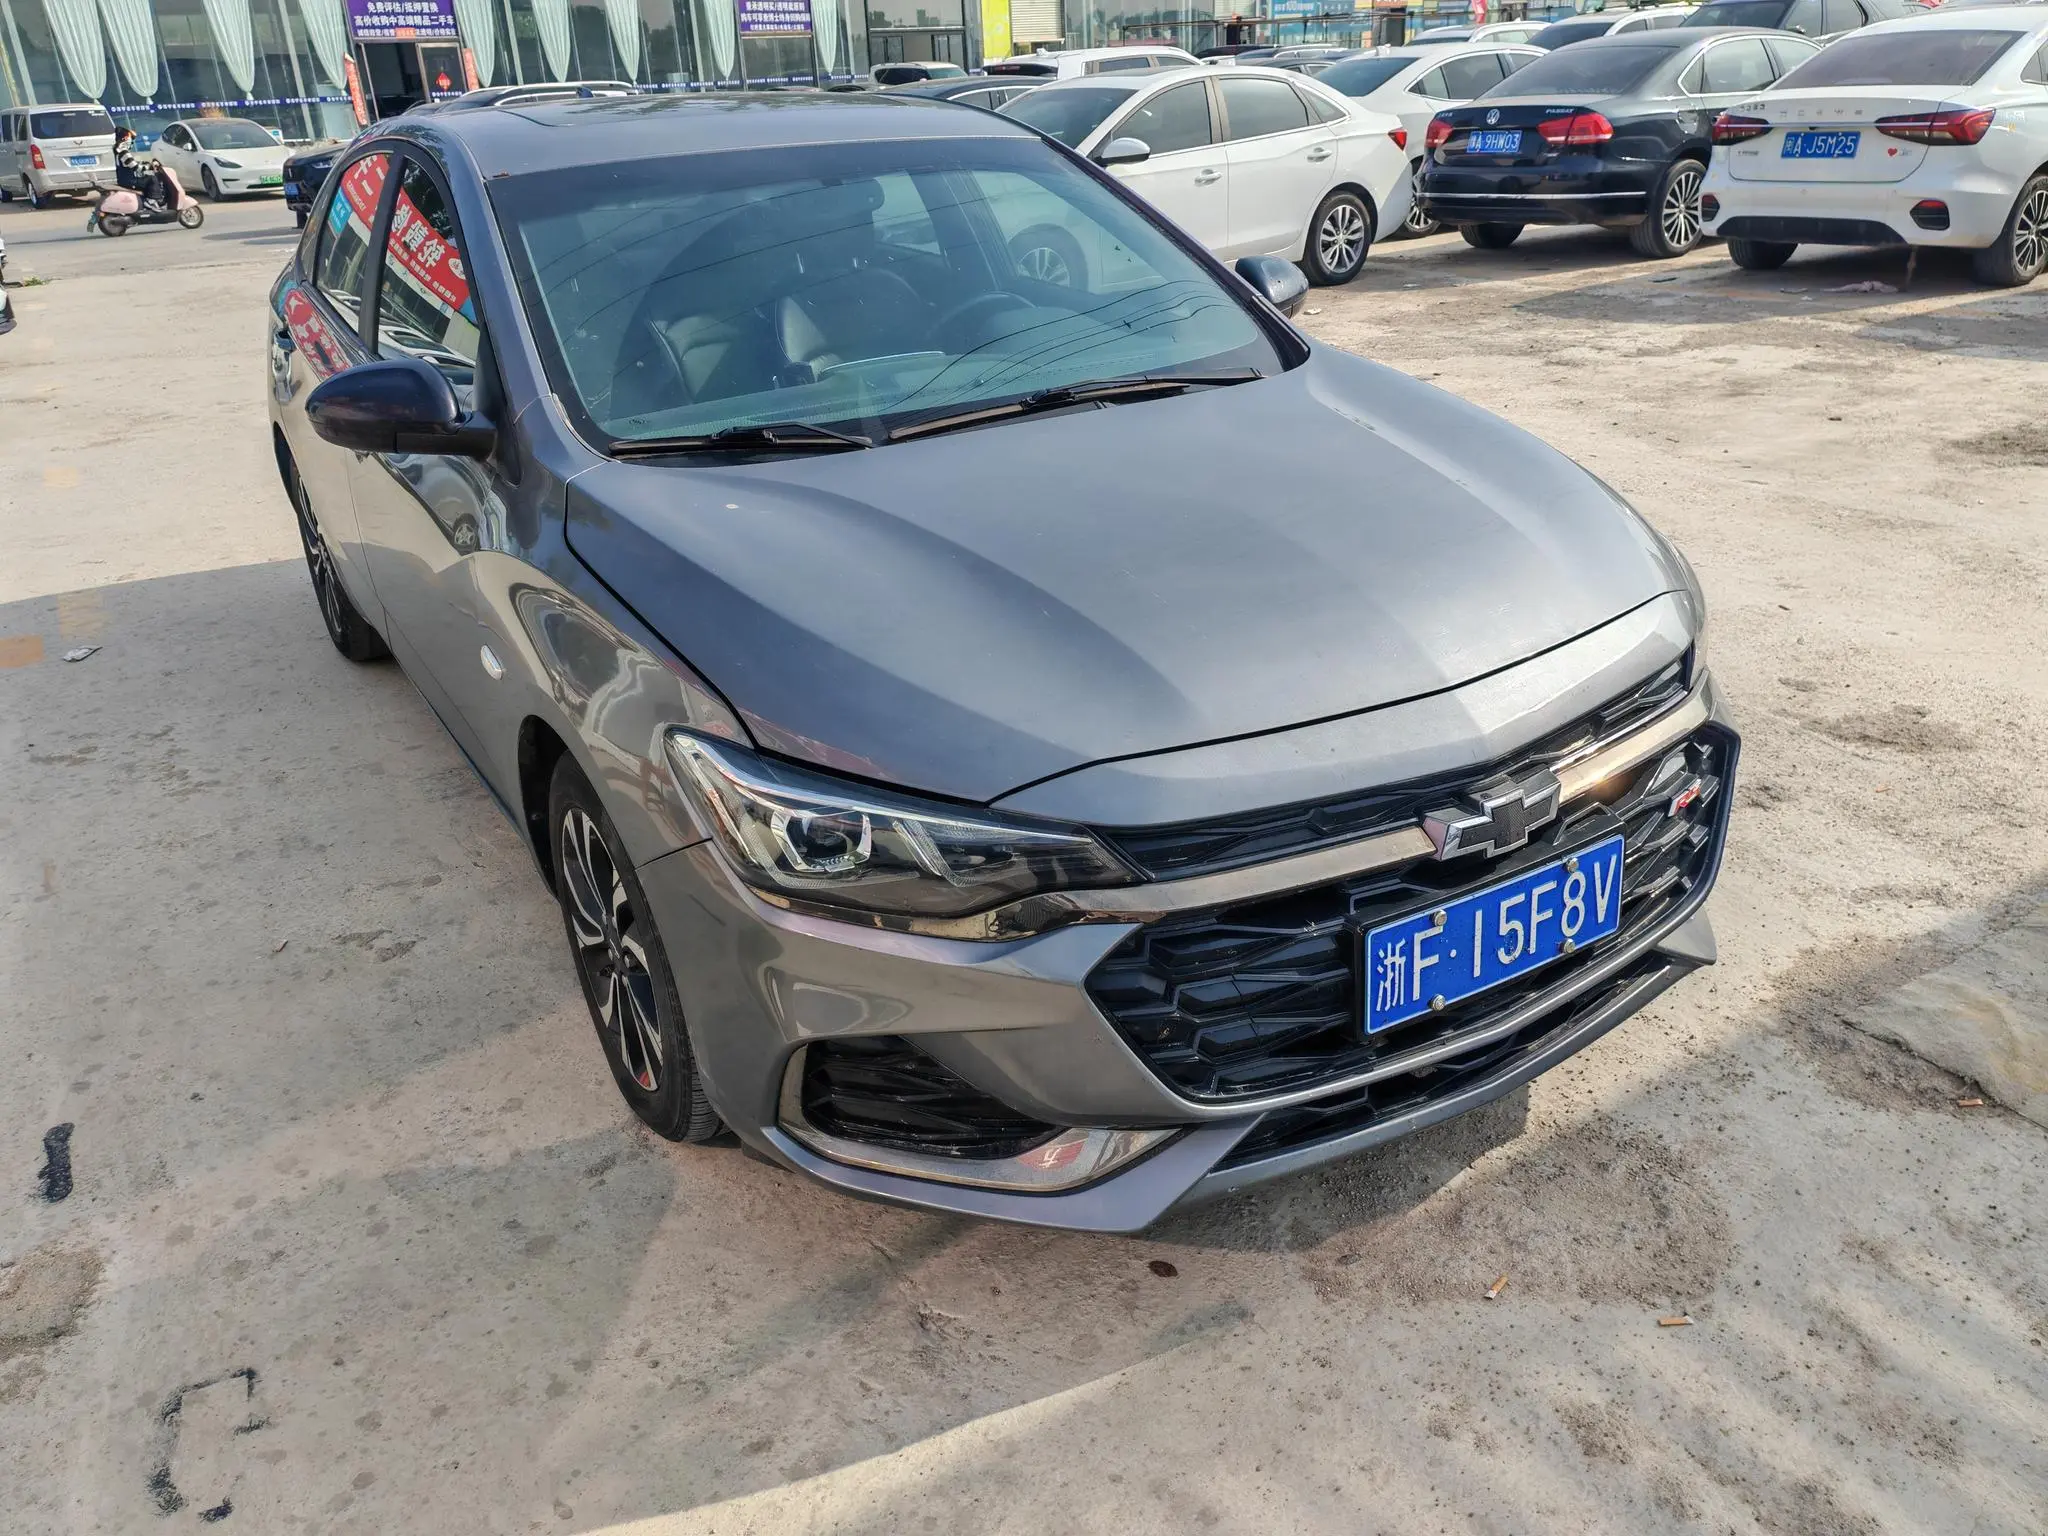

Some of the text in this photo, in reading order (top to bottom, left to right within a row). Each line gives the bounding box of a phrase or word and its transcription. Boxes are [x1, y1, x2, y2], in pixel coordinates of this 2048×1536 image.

[354, 15, 455, 26] 高价收购中高端精品二手车
